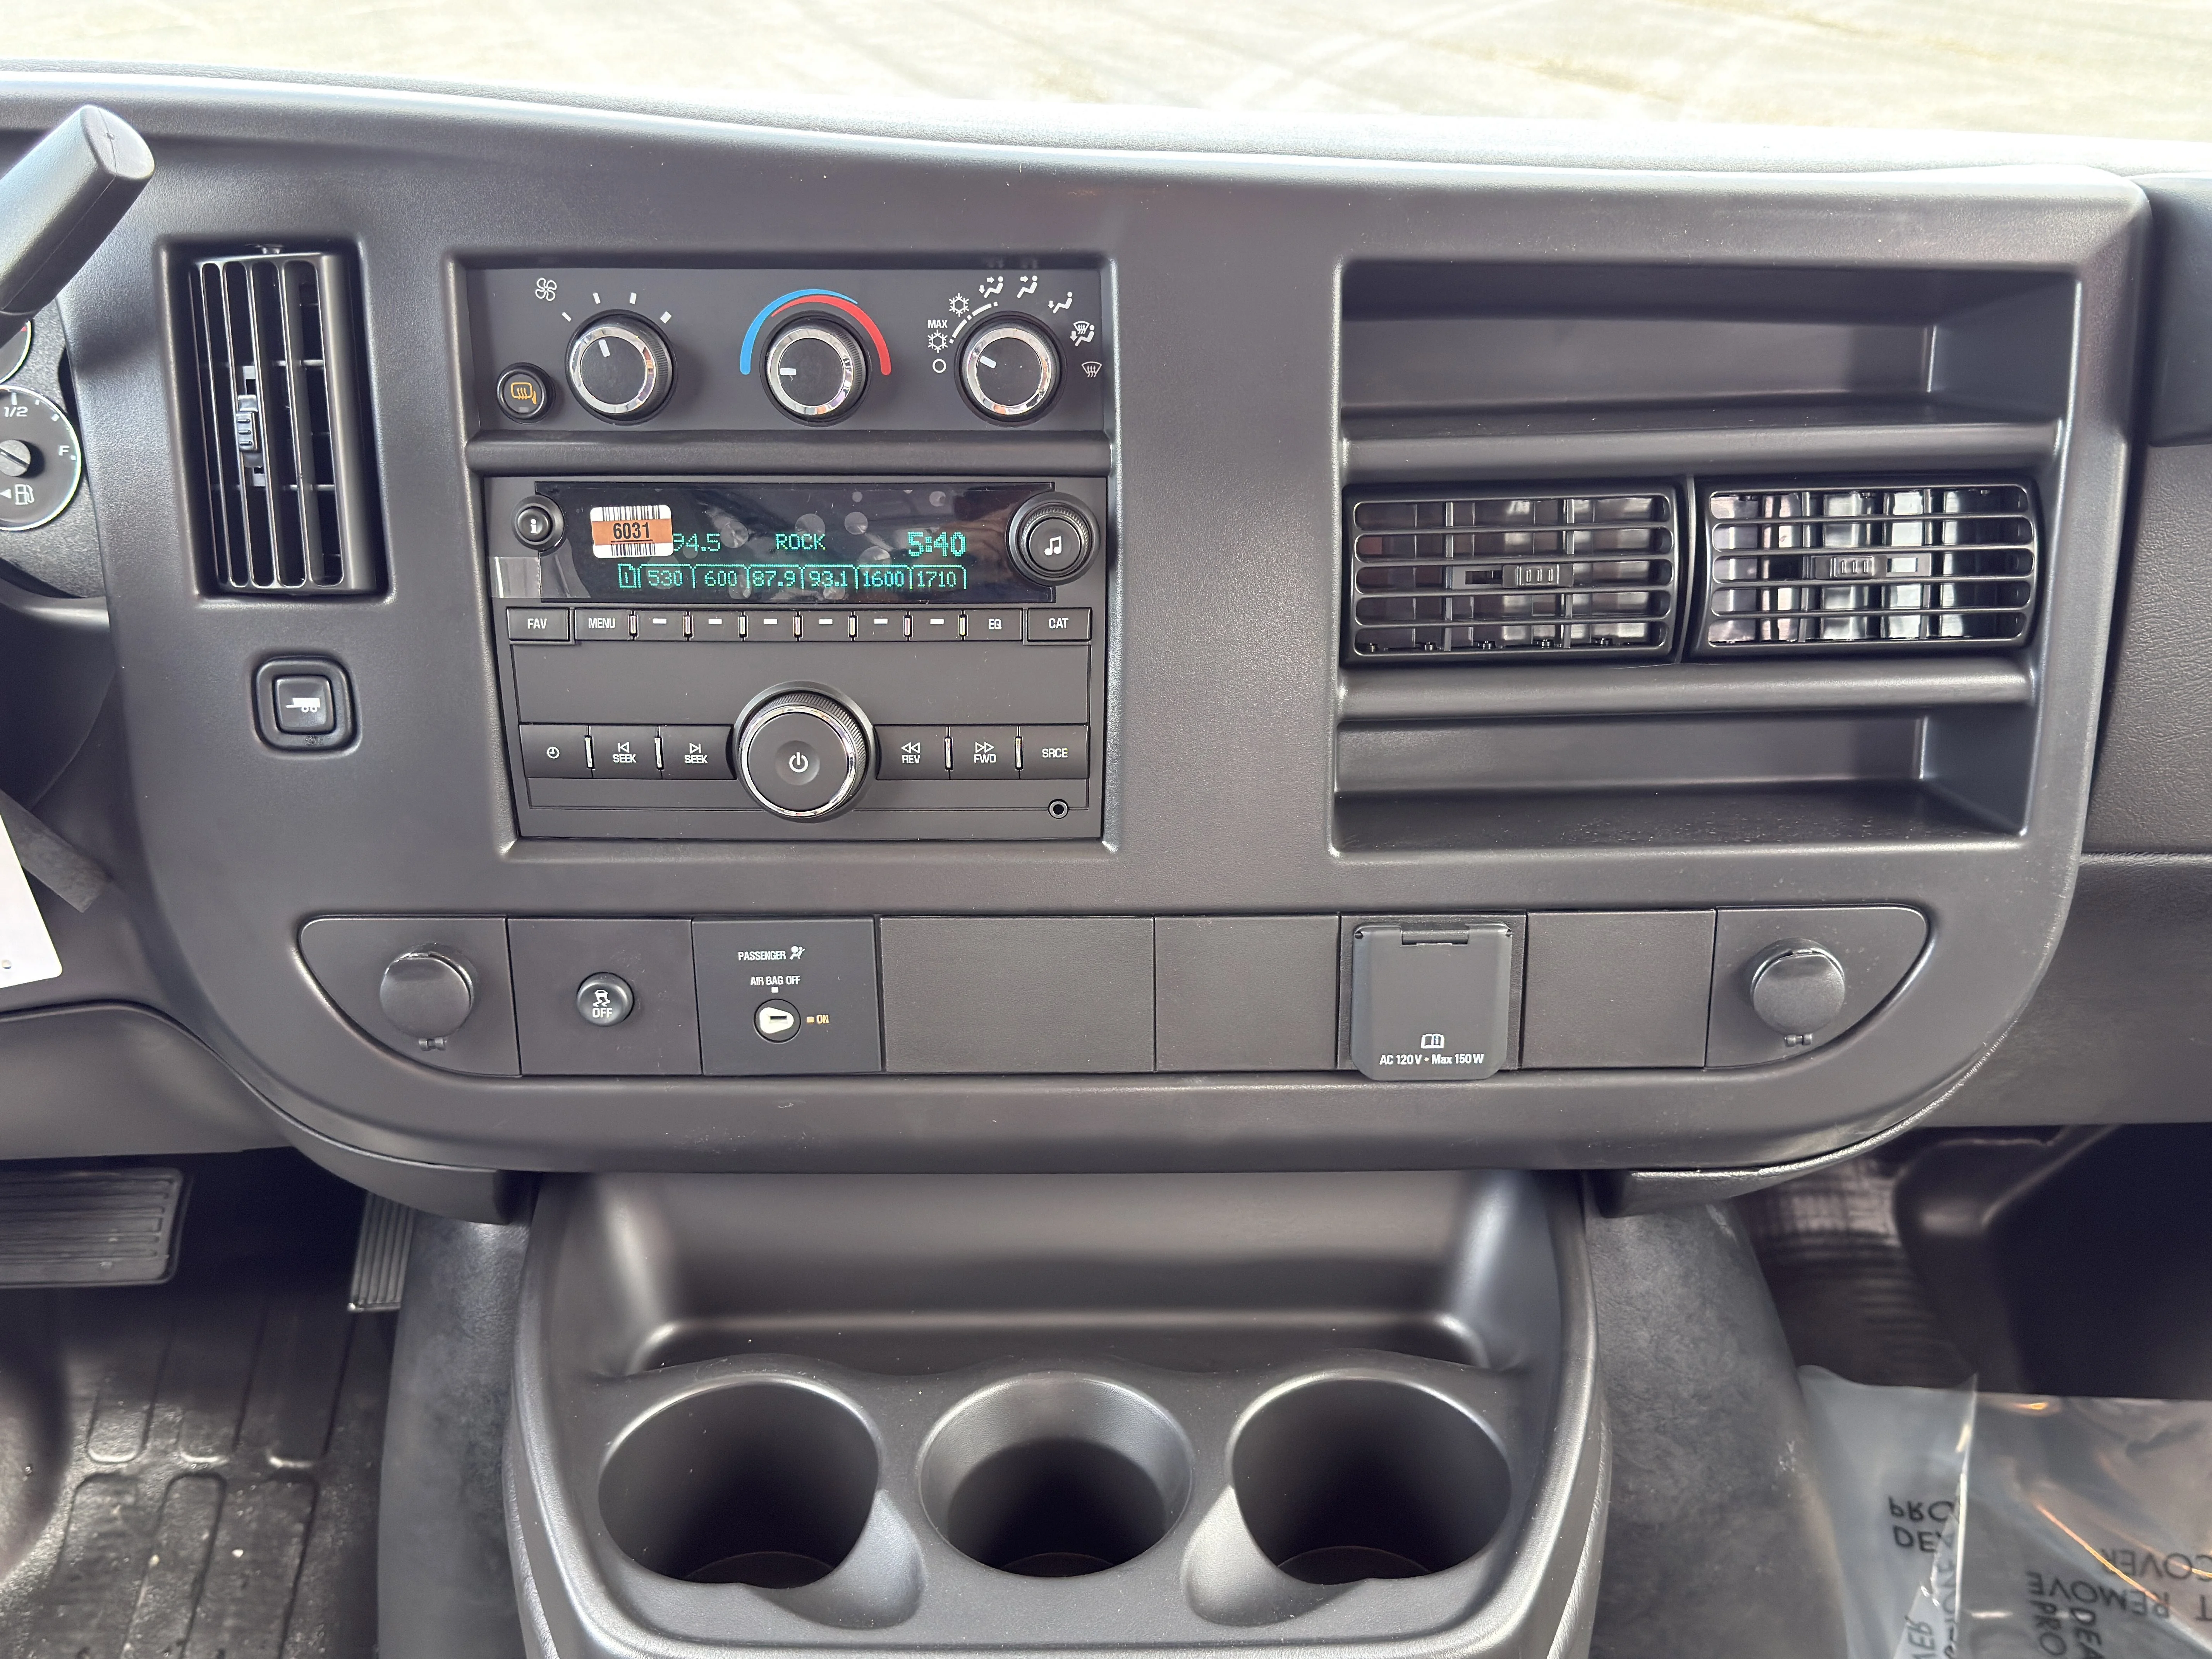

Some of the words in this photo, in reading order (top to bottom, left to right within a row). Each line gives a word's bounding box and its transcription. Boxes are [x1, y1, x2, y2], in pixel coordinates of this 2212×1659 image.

[928, 320, 948, 329] MAX
[4, 406, 28, 417] 1/2
[59, 445, 70, 456] F
[613, 522, 650, 539] 6031
[776, 534, 826, 550] ROCK
[908, 532, 966, 558] 5:40
[648, 570, 683, 587] 530
[705, 571, 738, 587] 600
[753, 570, 796, 587] 87.9
[809, 571, 848, 588] 93.1
[864, 571, 905, 588] 1600
[918, 571, 957, 588] 1710
[528, 618, 548, 629] FAV
[589, 618, 616, 629] MENU
[989, 619, 1002, 630] EQ
[1049, 618, 1069, 629] CAT
[613, 754, 637, 763] SEEK
[1042, 748, 1068, 758] SRCE
[685, 755, 708, 764] SEEK
[902, 755, 921, 764] REV
[974, 754, 997, 764] FWD
[738, 951, 787, 961] PASSENGER
[750, 977, 764, 986] AIR
[766, 976, 784, 986] BAG
[786, 976, 801, 985] OFF
[592, 1008, 613, 1018] OFF
[816, 1015, 830, 1025] ON
[1379, 1055, 1394, 1065] AC
[1432, 1054, 1453, 1065] Max
[2026, 1570, 2169, 1619] REMOVE
